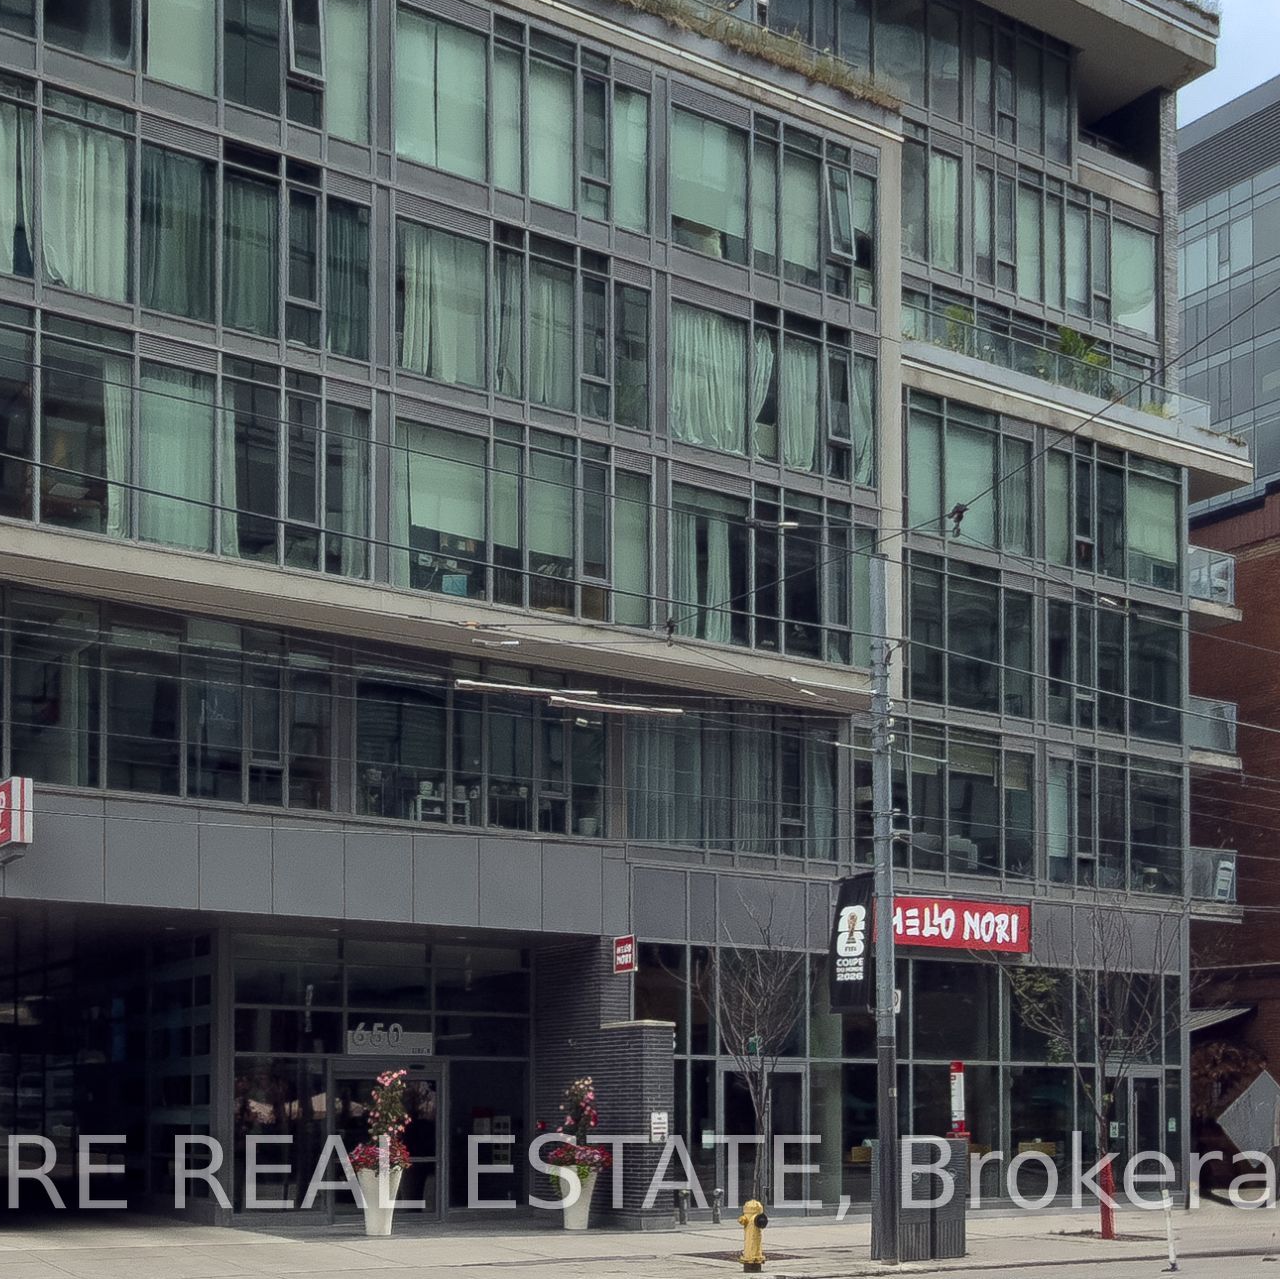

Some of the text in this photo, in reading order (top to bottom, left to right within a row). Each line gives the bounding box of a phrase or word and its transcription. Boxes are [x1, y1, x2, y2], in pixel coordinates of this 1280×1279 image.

[962, 910, 1019, 943] NORI
[836, 957, 865, 967] COUPE
[836, 972, 864, 981] 2026
[353, 1022, 403, 1047] 650
